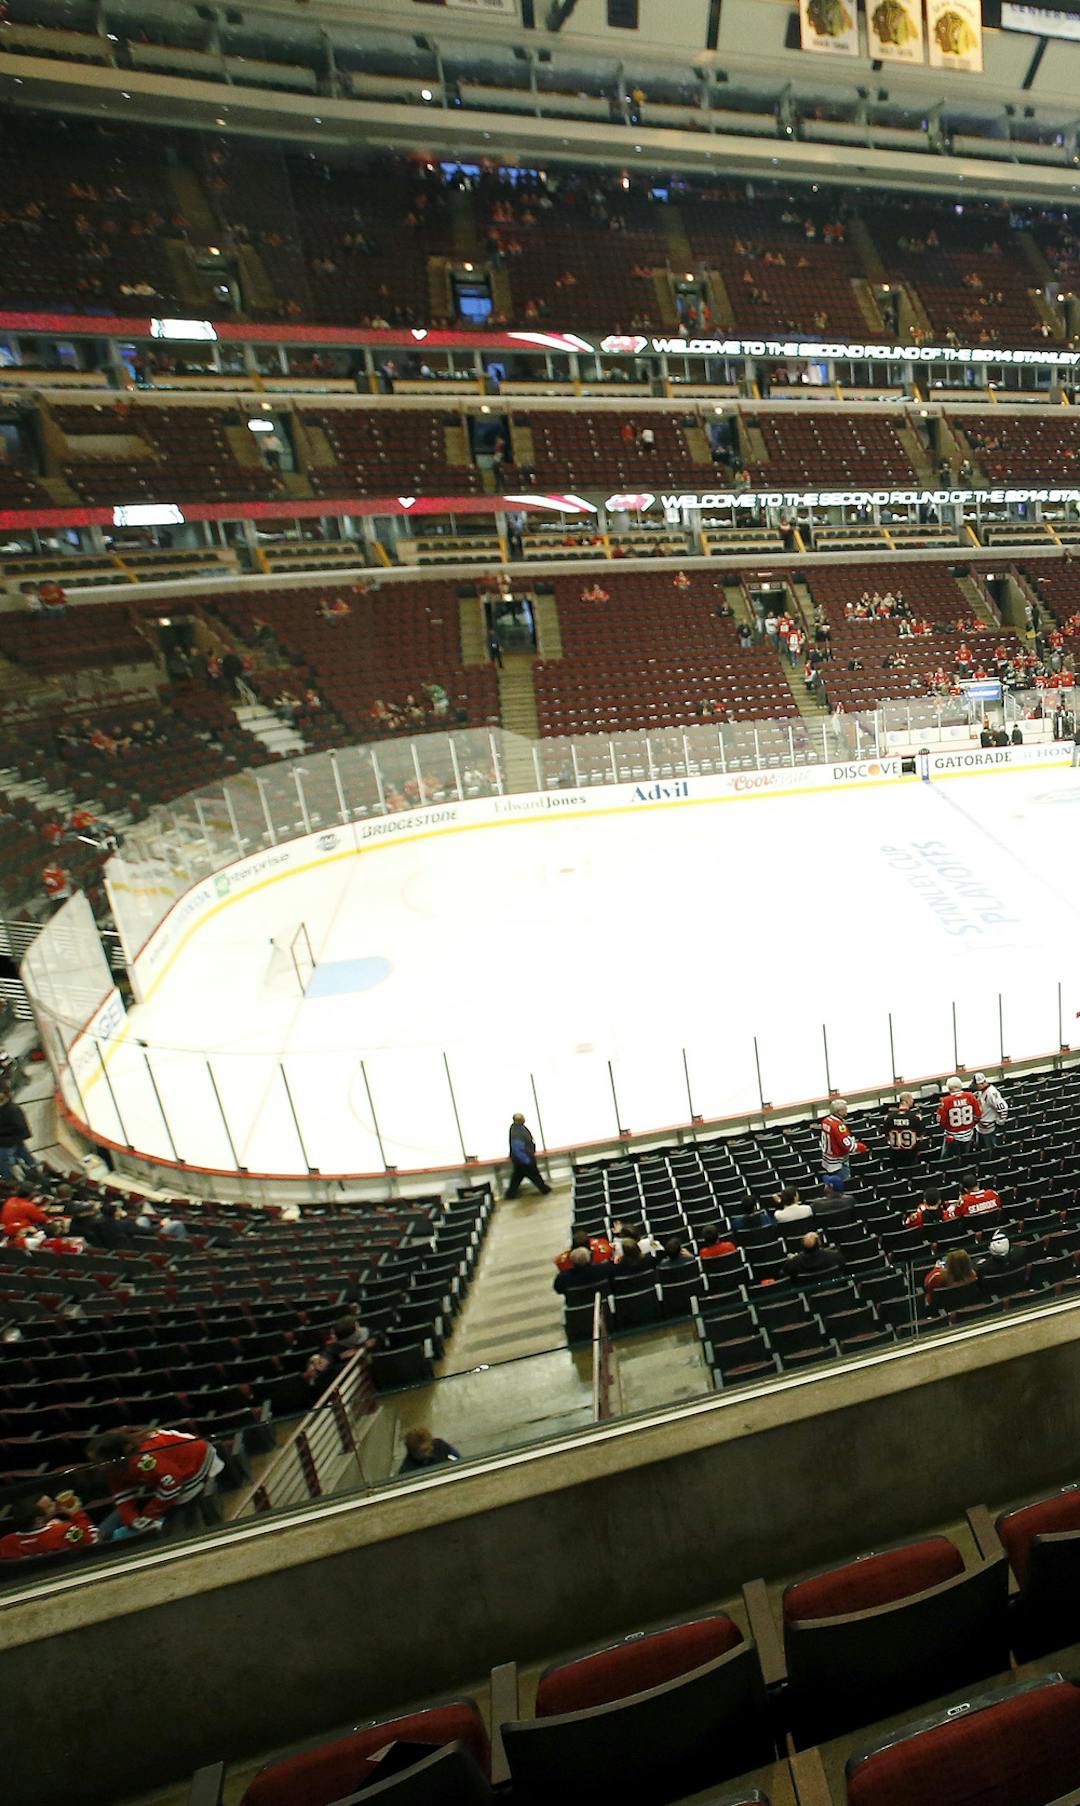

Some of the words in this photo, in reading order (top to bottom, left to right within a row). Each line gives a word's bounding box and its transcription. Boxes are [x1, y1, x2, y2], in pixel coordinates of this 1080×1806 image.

[653, 338, 740, 355] WELCOME
[741, 341, 766, 356] TO
[766, 342, 799, 357] THE
[799, 343, 864, 359] SECOND
[865, 345, 920, 360] ROUND
[920, 347, 943, 361] OF
[943, 348, 972, 362] THE
[1014, 350, 1080, 365] STANLEY
[660, 494, 756, 509] WELCOME
[757, 494, 782, 508] TO
[783, 493, 819, 508] THE
[819, 492, 889, 507] SECOND
[889, 491, 953, 505] ROUND
[953, 490, 971, 504] OF
[971, 490, 1005, 504] THE
[832, 760, 901, 782] DISCOVE
[934, 751, 1013, 770] GATORADE
[632, 782, 689, 802] Advil
[361, 808, 459, 841] BRIDGESTONE
[949, 1105, 974, 1127] 88
[889, 1129, 917, 1150] 19
